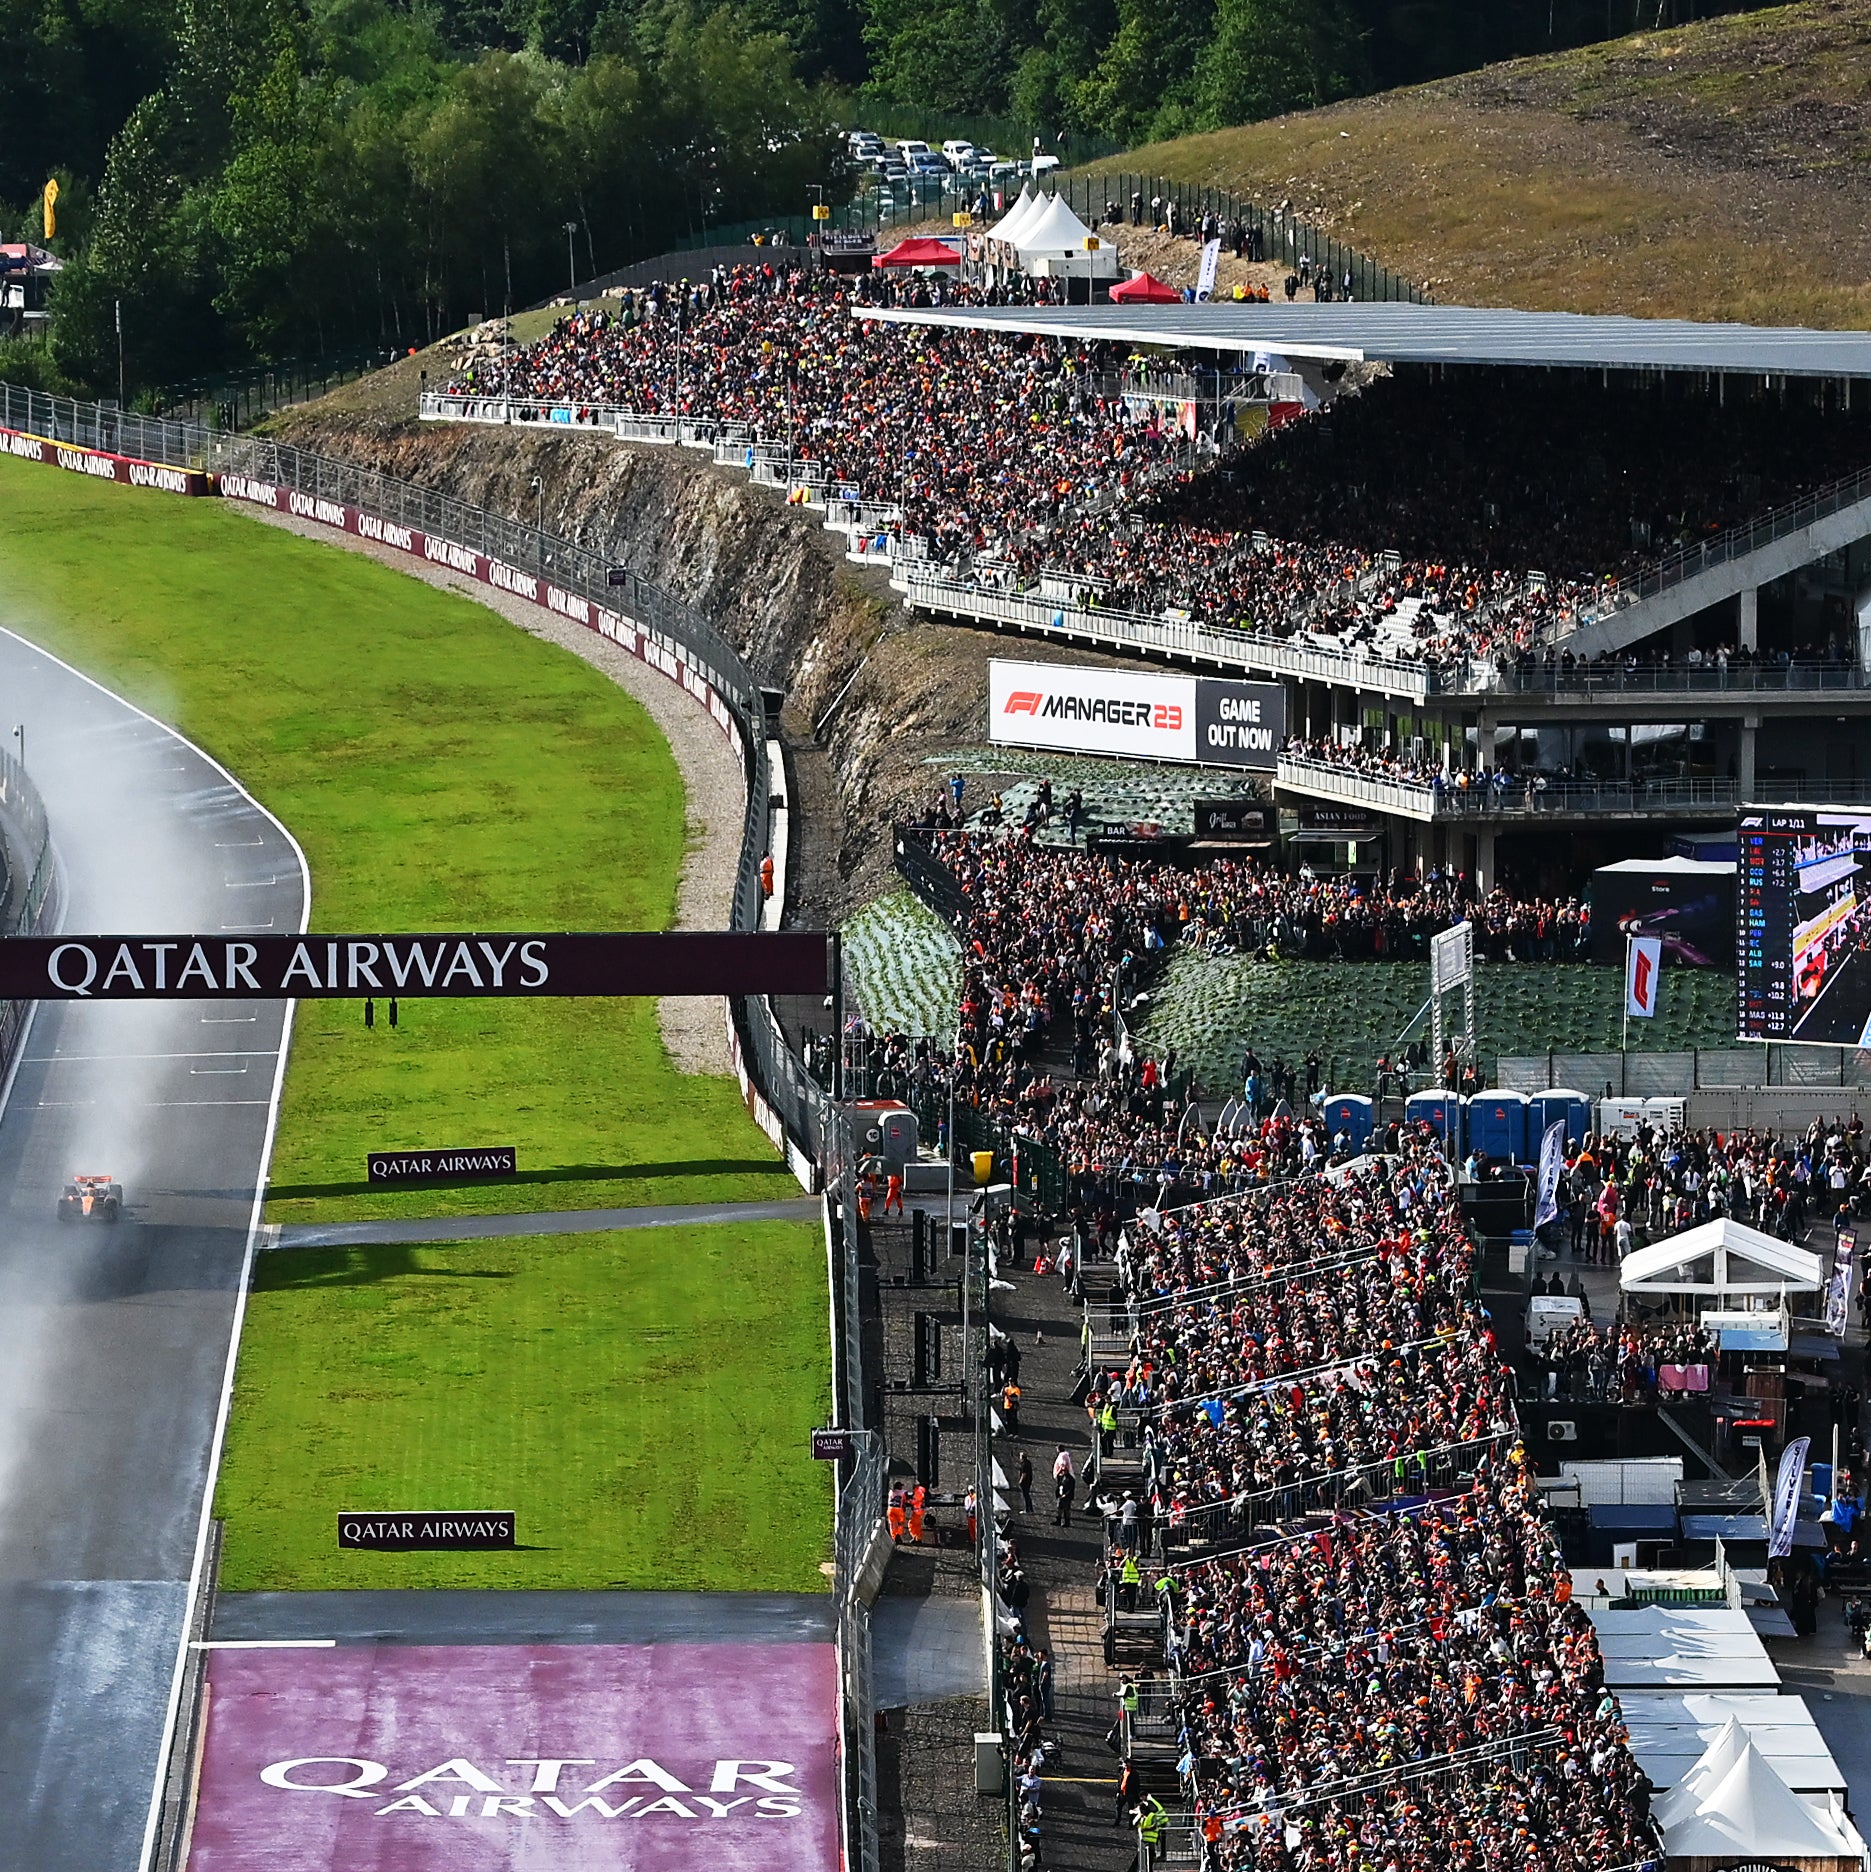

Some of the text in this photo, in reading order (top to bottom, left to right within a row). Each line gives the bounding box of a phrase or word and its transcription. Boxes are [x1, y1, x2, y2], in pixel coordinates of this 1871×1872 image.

[10, 435, 43, 461] AIRWAYS
[57, 448, 115, 479] QATAR AIRWAYS
[129, 463, 186, 493] QATAR AIRWAYS
[221, 474, 277, 506] QATAR AIRWAYS
[289, 492, 345, 527] QATAR AIRWAYS
[358, 513, 412, 550] QATAR AIRWAYS
[1042, 694, 1182, 730] MANAGER 23
[1219, 697, 1261, 723] GAME
[1207, 724, 1272, 751] OUT NOW
[1107, 826, 1126, 836] BAR
[1772, 818, 1787, 827] LAP
[47, 940, 550, 997] QATAR AIRWAYS
[372, 1154, 511, 1177] QATAR AIRWAYS
[816, 1437, 844, 1447] QATAR
[344, 1519, 509, 1543] QATAR AIRWAYS
[259, 1756, 803, 1798] QATAR
[374, 1796, 804, 1819] AIRWAYS
